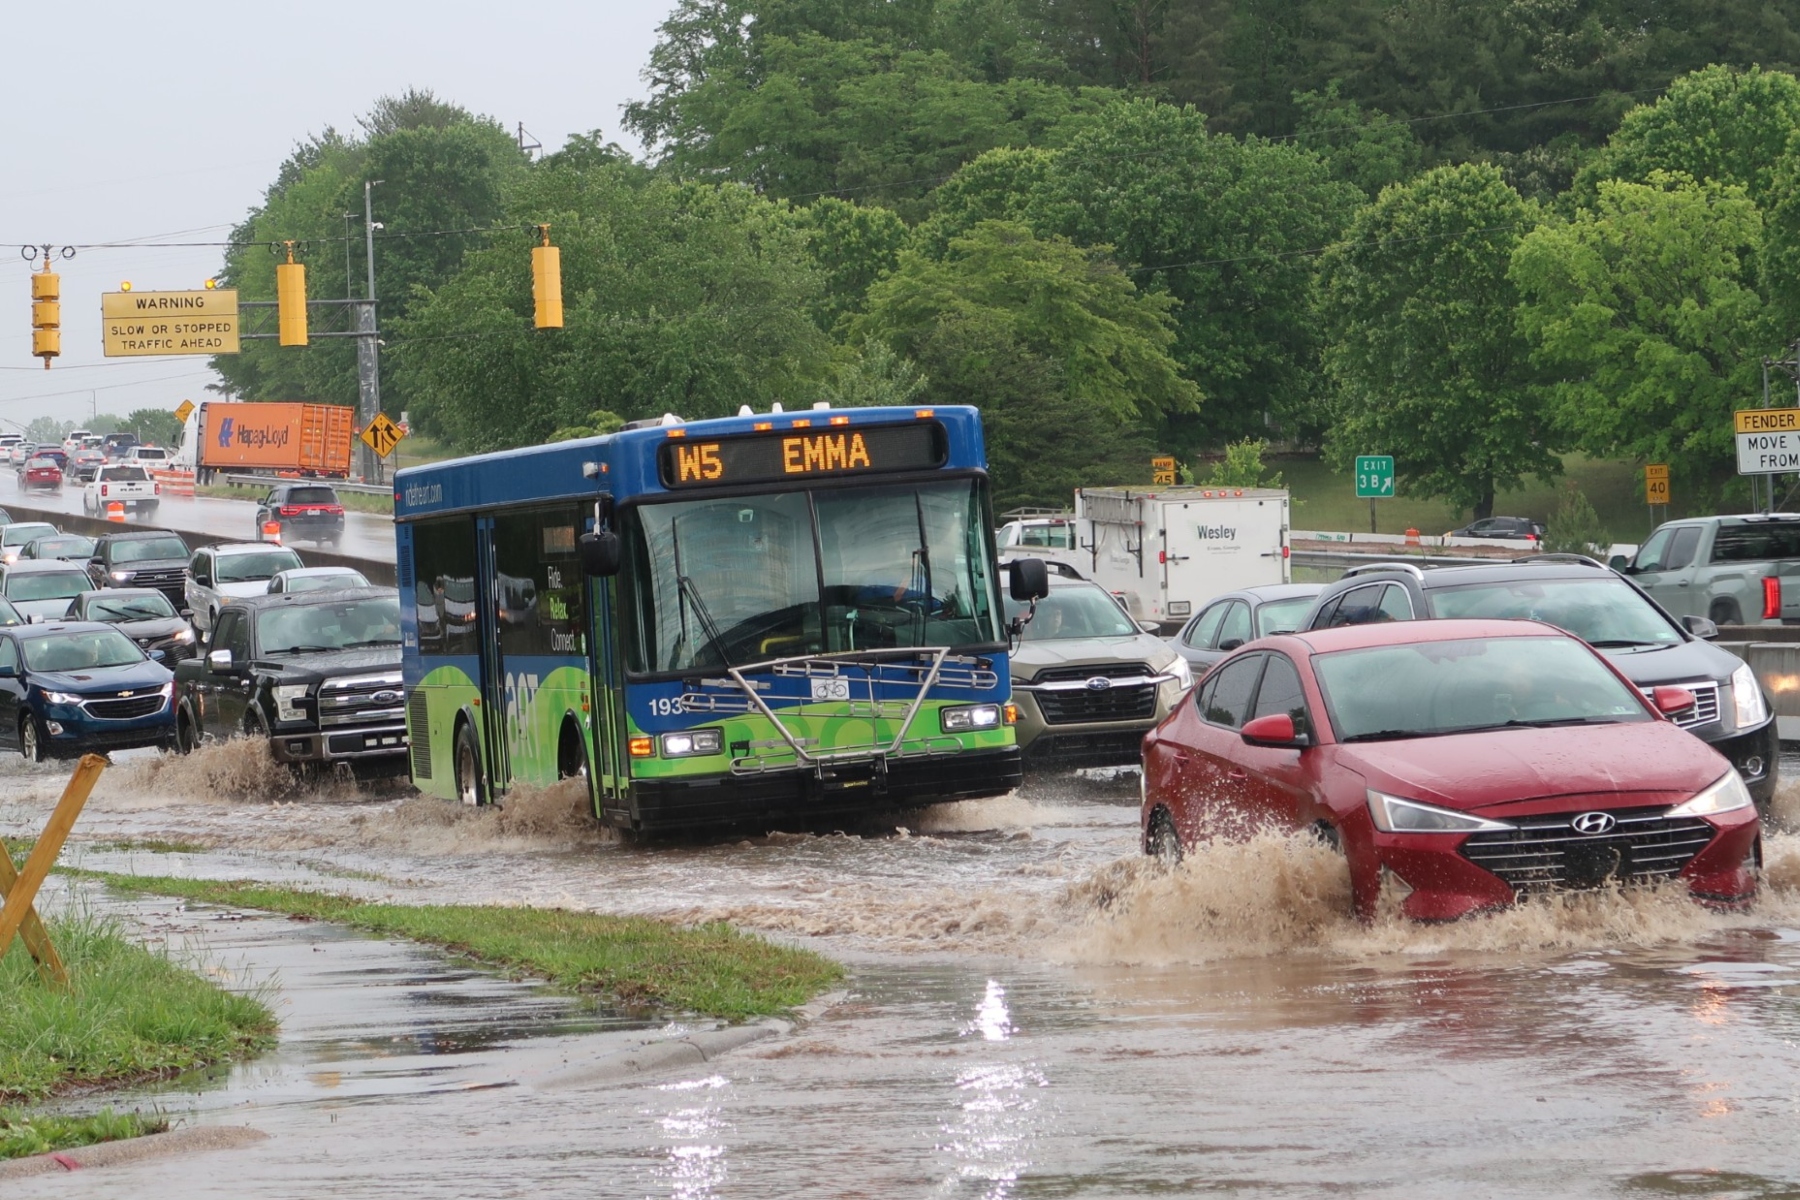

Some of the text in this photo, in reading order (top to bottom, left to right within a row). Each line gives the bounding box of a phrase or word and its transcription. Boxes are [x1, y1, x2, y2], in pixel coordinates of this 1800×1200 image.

[136, 296, 205, 309] WARNING
[111, 323, 231, 335] SLOW OR STOPPED
[121, 338, 222, 350] TRAFFIC AHEAD
[1744, 414, 1796, 429] FENDER
[237, 424, 289, 449] Hapag-Lloyd
[1748, 435, 1787, 450] MOVE
[678, 433, 871, 482] W5 EMMA
[1363, 460, 1387, 470] EXIT
[1760, 453, 1799, 468] FROM
[1360, 474, 1379, 488] 3 B
[1650, 481, 1666, 494] 40
[1197, 524, 1236, 541] Wesley
[547, 566, 563, 589] Ride.
[549, 597, 569, 620] Relax.
[551, 628, 576, 652] Connect.
